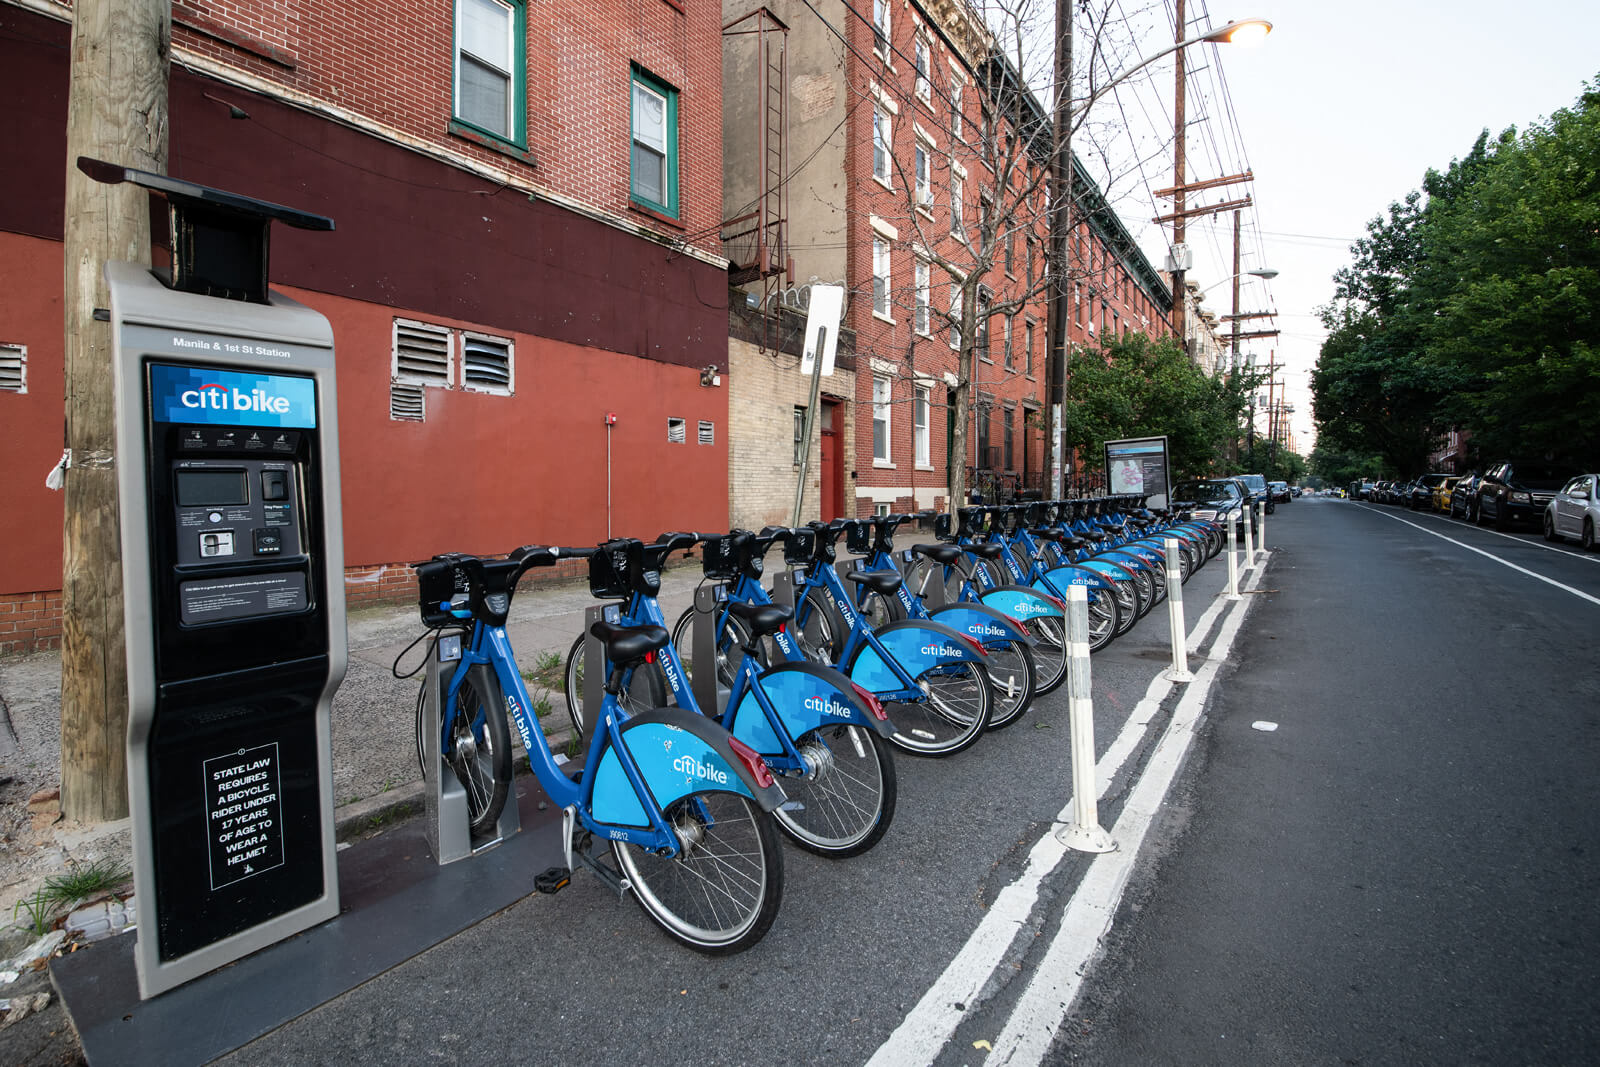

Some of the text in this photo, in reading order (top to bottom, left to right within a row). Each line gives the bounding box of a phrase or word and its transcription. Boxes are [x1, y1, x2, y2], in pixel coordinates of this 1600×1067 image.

[174, 338, 291, 358] Manila & 1st St Station
[181, 383, 290, 413] citi bike
[1029, 605, 1048, 613] bike
[969, 624, 1006, 636] citi bike
[921, 644, 962, 657] citi bike
[659, 648, 679, 692] citi bike
[805, 696, 851, 718] citi bike
[508, 695, 532, 750] citi bike
[213, 758, 270, 780] STATE LAW
[674, 755, 727, 784] citi bike
[218, 771, 268, 792] REQUIRES
[218, 783, 270, 805] A BICYCLE
[211, 794, 276, 820] RIDER UNDER
[222, 808, 268, 830] 17 YEARS
[219, 819, 272, 843] OF AGE TO
[226, 833, 268, 854] WEAR A
[227, 845, 267, 866] HELMET
